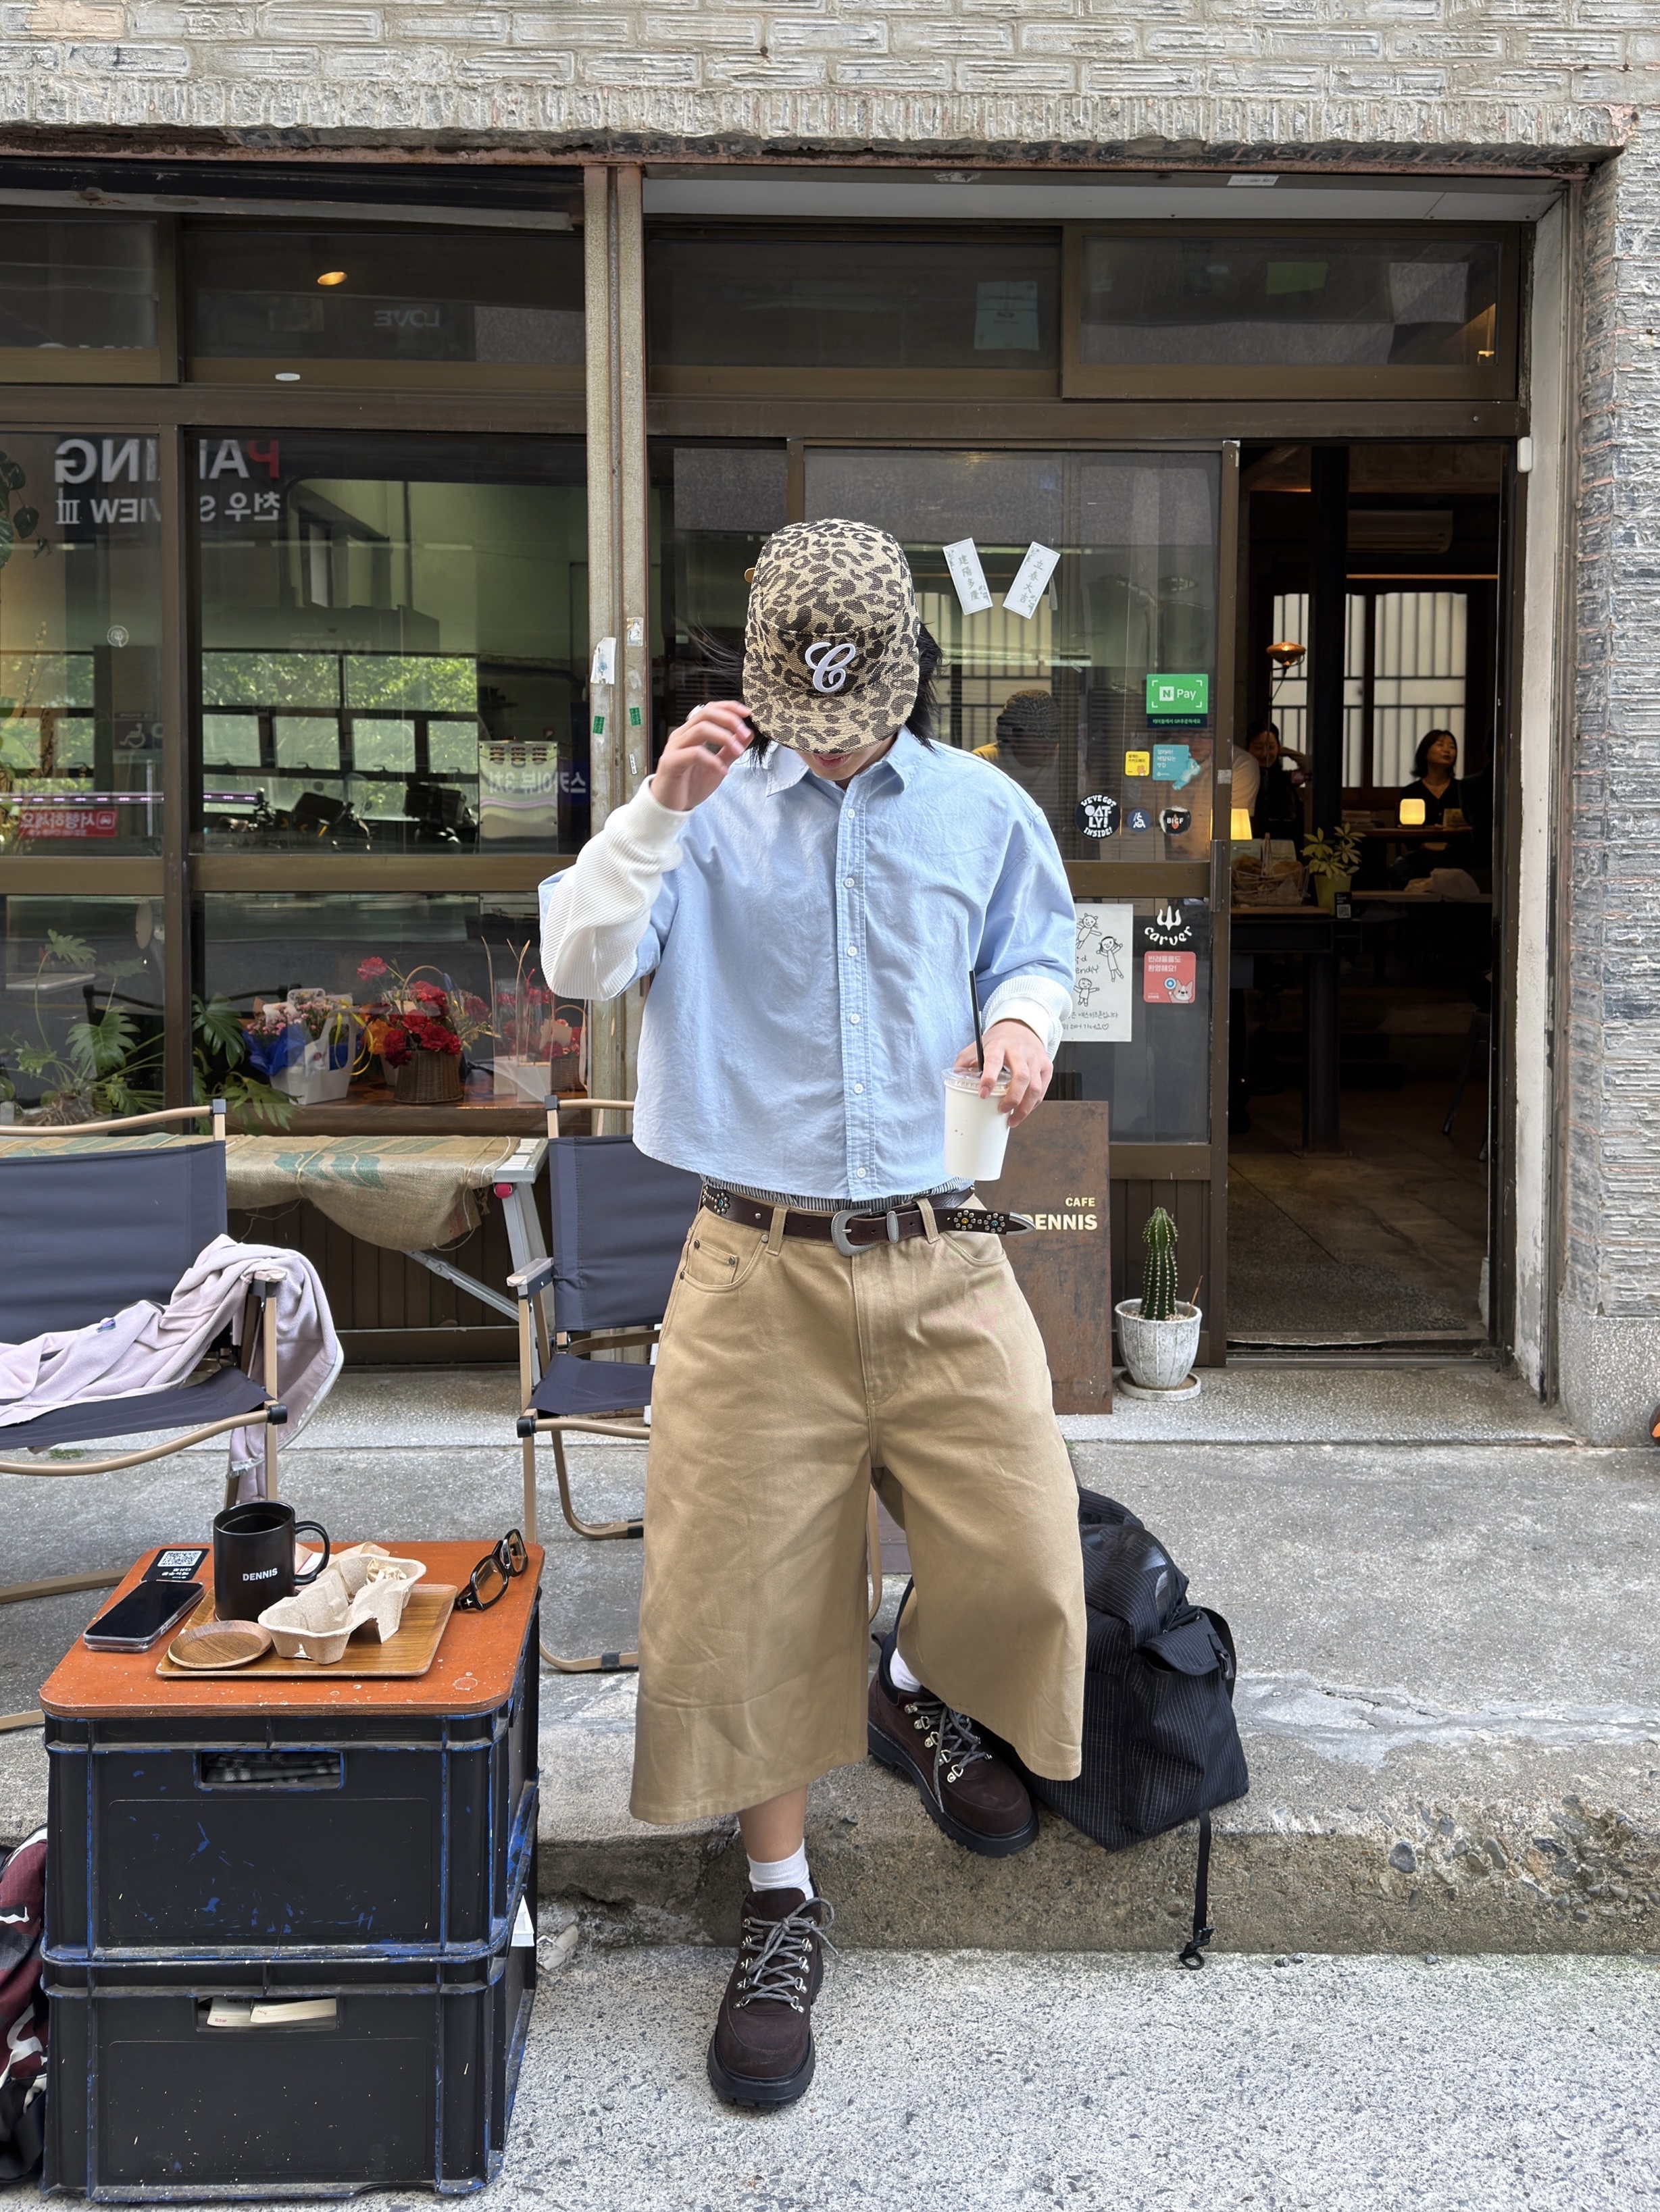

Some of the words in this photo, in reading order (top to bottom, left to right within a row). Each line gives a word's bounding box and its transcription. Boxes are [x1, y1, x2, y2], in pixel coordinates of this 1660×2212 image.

[1019, 559, 1045, 604] 立春大吉
[1176, 689, 1197, 701] Pay
[1080, 794, 1102, 807] WE'VE
[1103, 796, 1117, 808] GOT
[1088, 816, 1109, 829] LY!
[1083, 826, 1113, 838] INSIDE!
[1144, 925, 1192, 946] carver
[1076, 954, 1087, 966] id
[1148, 955, 1182, 963] 반려동물도
[1148, 964, 1178, 973] 환영해요!
[1065, 1197, 1096, 1207] CAFE
[242, 1568, 278, 1581] DENNIS
